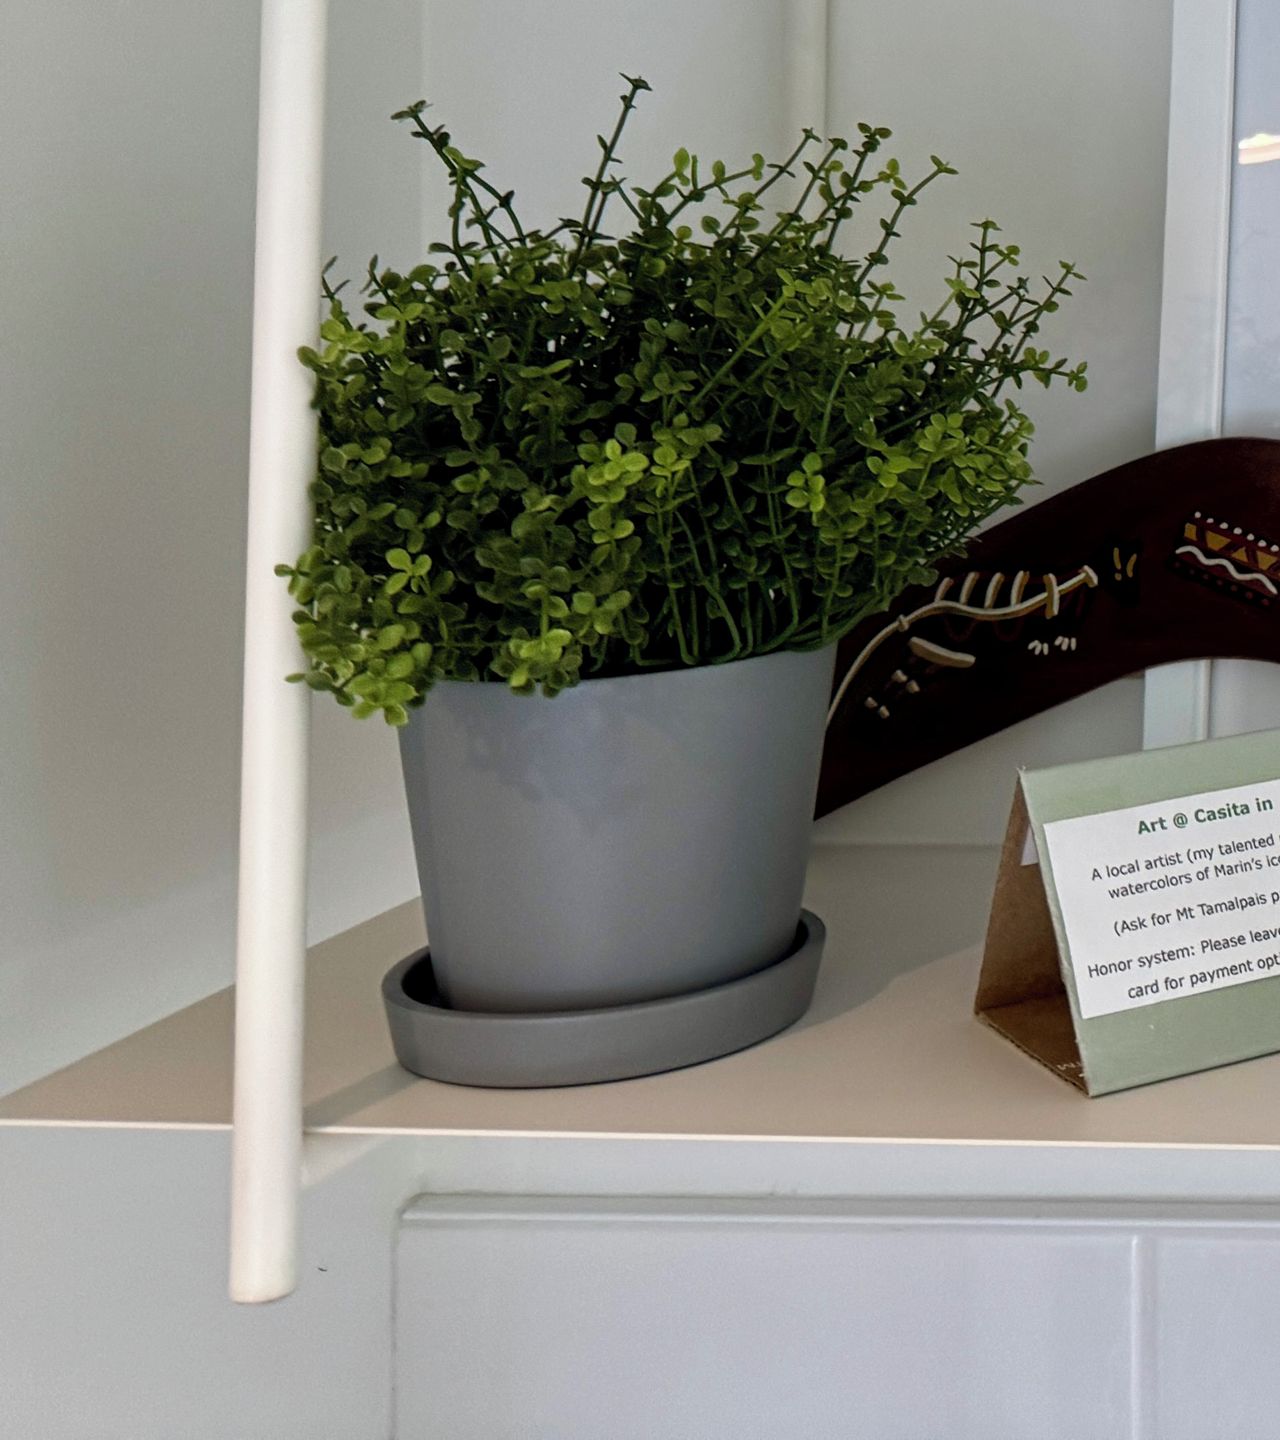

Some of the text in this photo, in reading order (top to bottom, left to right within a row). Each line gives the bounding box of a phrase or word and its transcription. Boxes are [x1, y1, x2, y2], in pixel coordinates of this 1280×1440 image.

[1137, 816, 1168, 835] Art
[1172, 812, 1189, 829] @
[1193, 802, 1251, 824] Casita
[1254, 797, 1274, 813] in
[1091, 867, 1103, 881] A
[1105, 859, 1141, 878] local
[1144, 851, 1184, 871] artist
[1186, 847, 1214, 865] (my
[1217, 833, 1275, 856] talented
[1107, 872, 1193, 899] watercolors
[1195, 866, 1210, 882] of
[1113, 916, 1148, 937] (Ask
[1150, 912, 1172, 927] for
[1175, 906, 1196, 922] Mt
[1196, 892, 1268, 917] Tamalpais
[1087, 958, 1133, 979] Honor
[1137, 945, 1196, 969] system:
[1200, 934, 1247, 954] Please
[1127, 979, 1160, 999] card
[1163, 976, 1185, 991] for
[1189, 959, 1254, 988] payment
